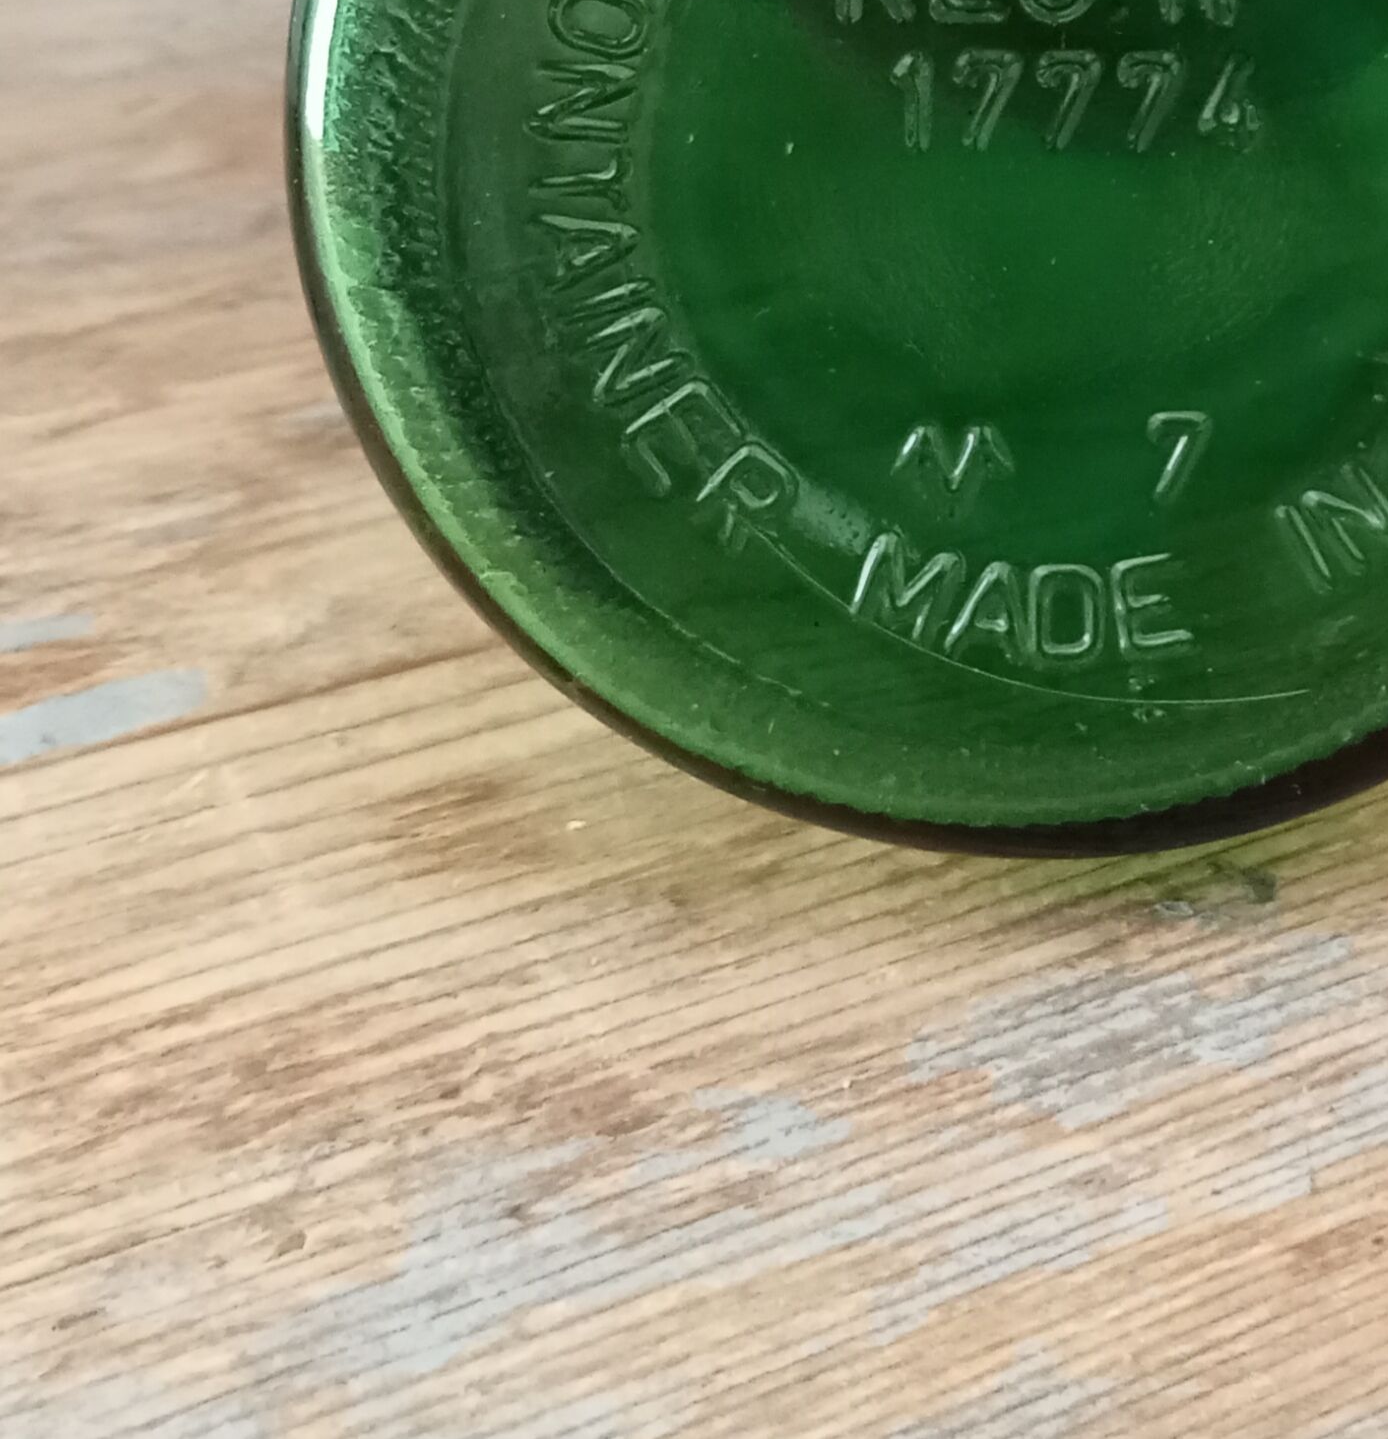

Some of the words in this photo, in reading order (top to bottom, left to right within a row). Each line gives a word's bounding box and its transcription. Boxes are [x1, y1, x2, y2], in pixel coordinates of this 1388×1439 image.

[890, 47, 1265, 154] 17774
[1146, 410, 1212, 500] 7
[848, 530, 1195, 662] MADE
